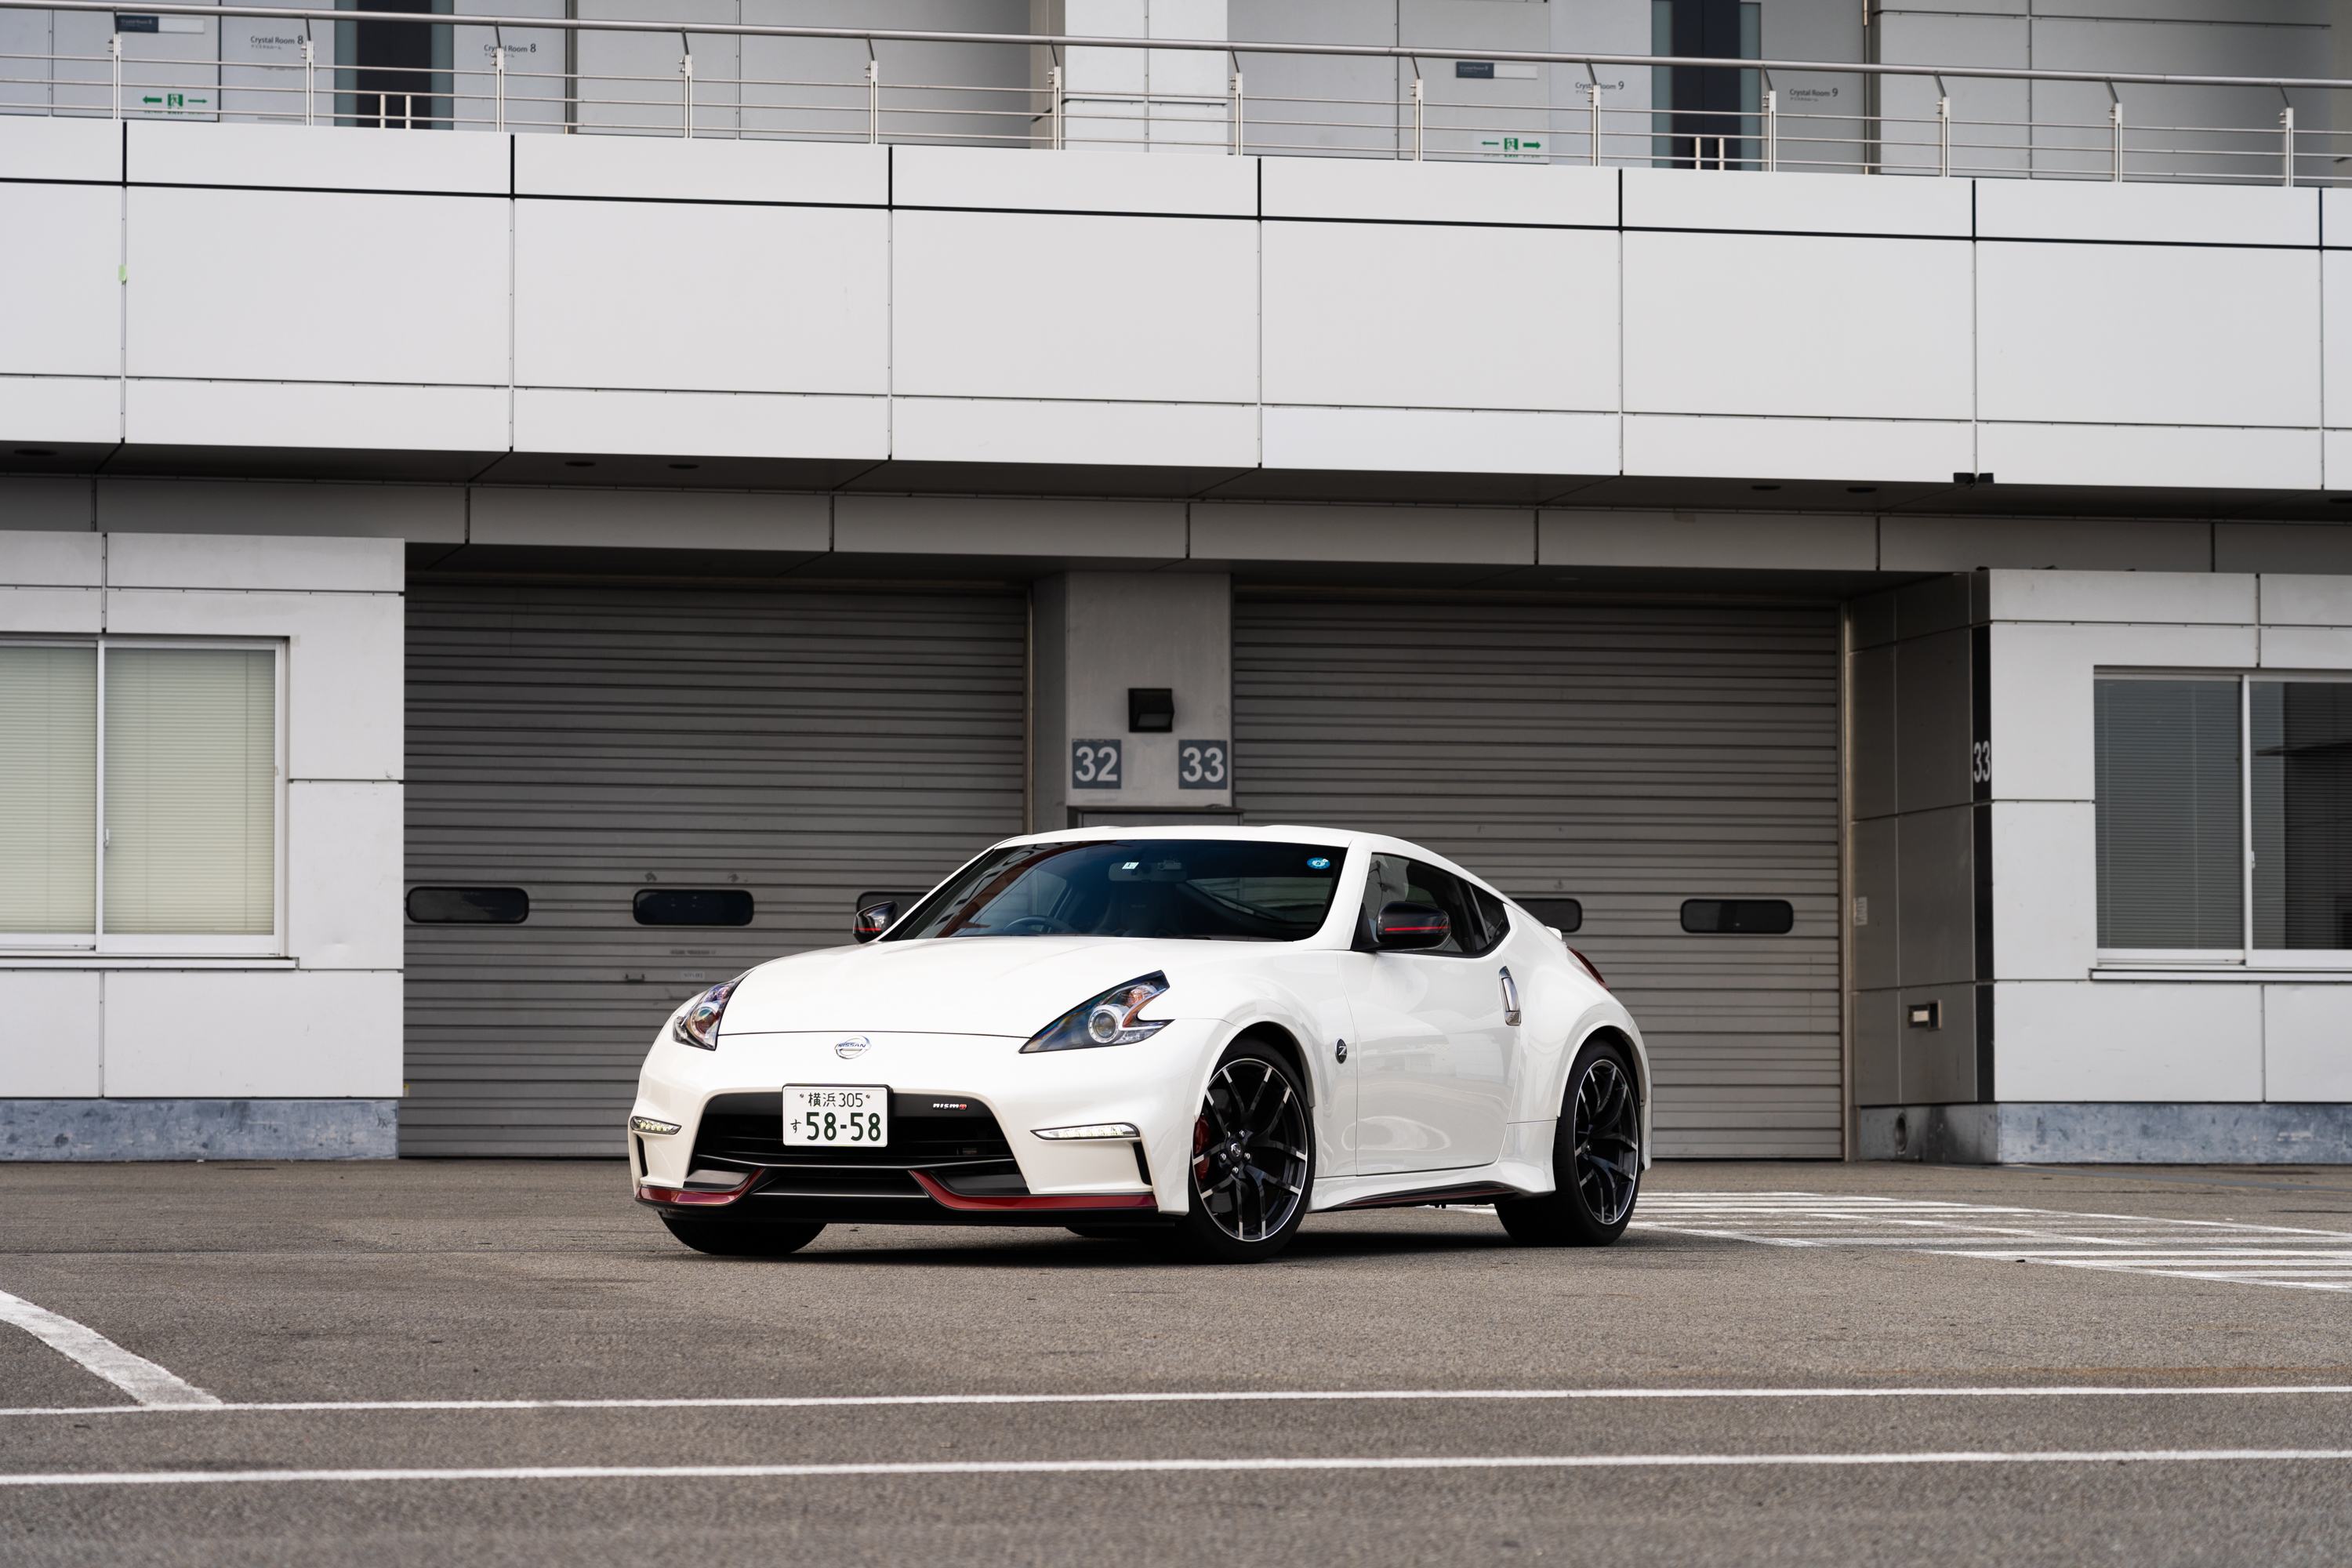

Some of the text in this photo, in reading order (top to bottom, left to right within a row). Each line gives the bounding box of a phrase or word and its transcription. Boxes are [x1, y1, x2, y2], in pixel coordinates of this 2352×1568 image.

[250, 35, 274, 44] Crystal
[297, 34, 303, 45] 8
[530, 43, 536, 53] 8
[1618, 81, 1624, 90] 9
[1831, 87, 1838, 97] 9
[1075, 746, 1118, 782] 32
[1181, 746, 1225, 782] 33
[1973, 740, 1991, 783] 33
[1338, 1045, 1348, 1056] Z
[808, 1092, 863, 1108] 横浜 305
[790, 1112, 881, 1142] す 58-58
